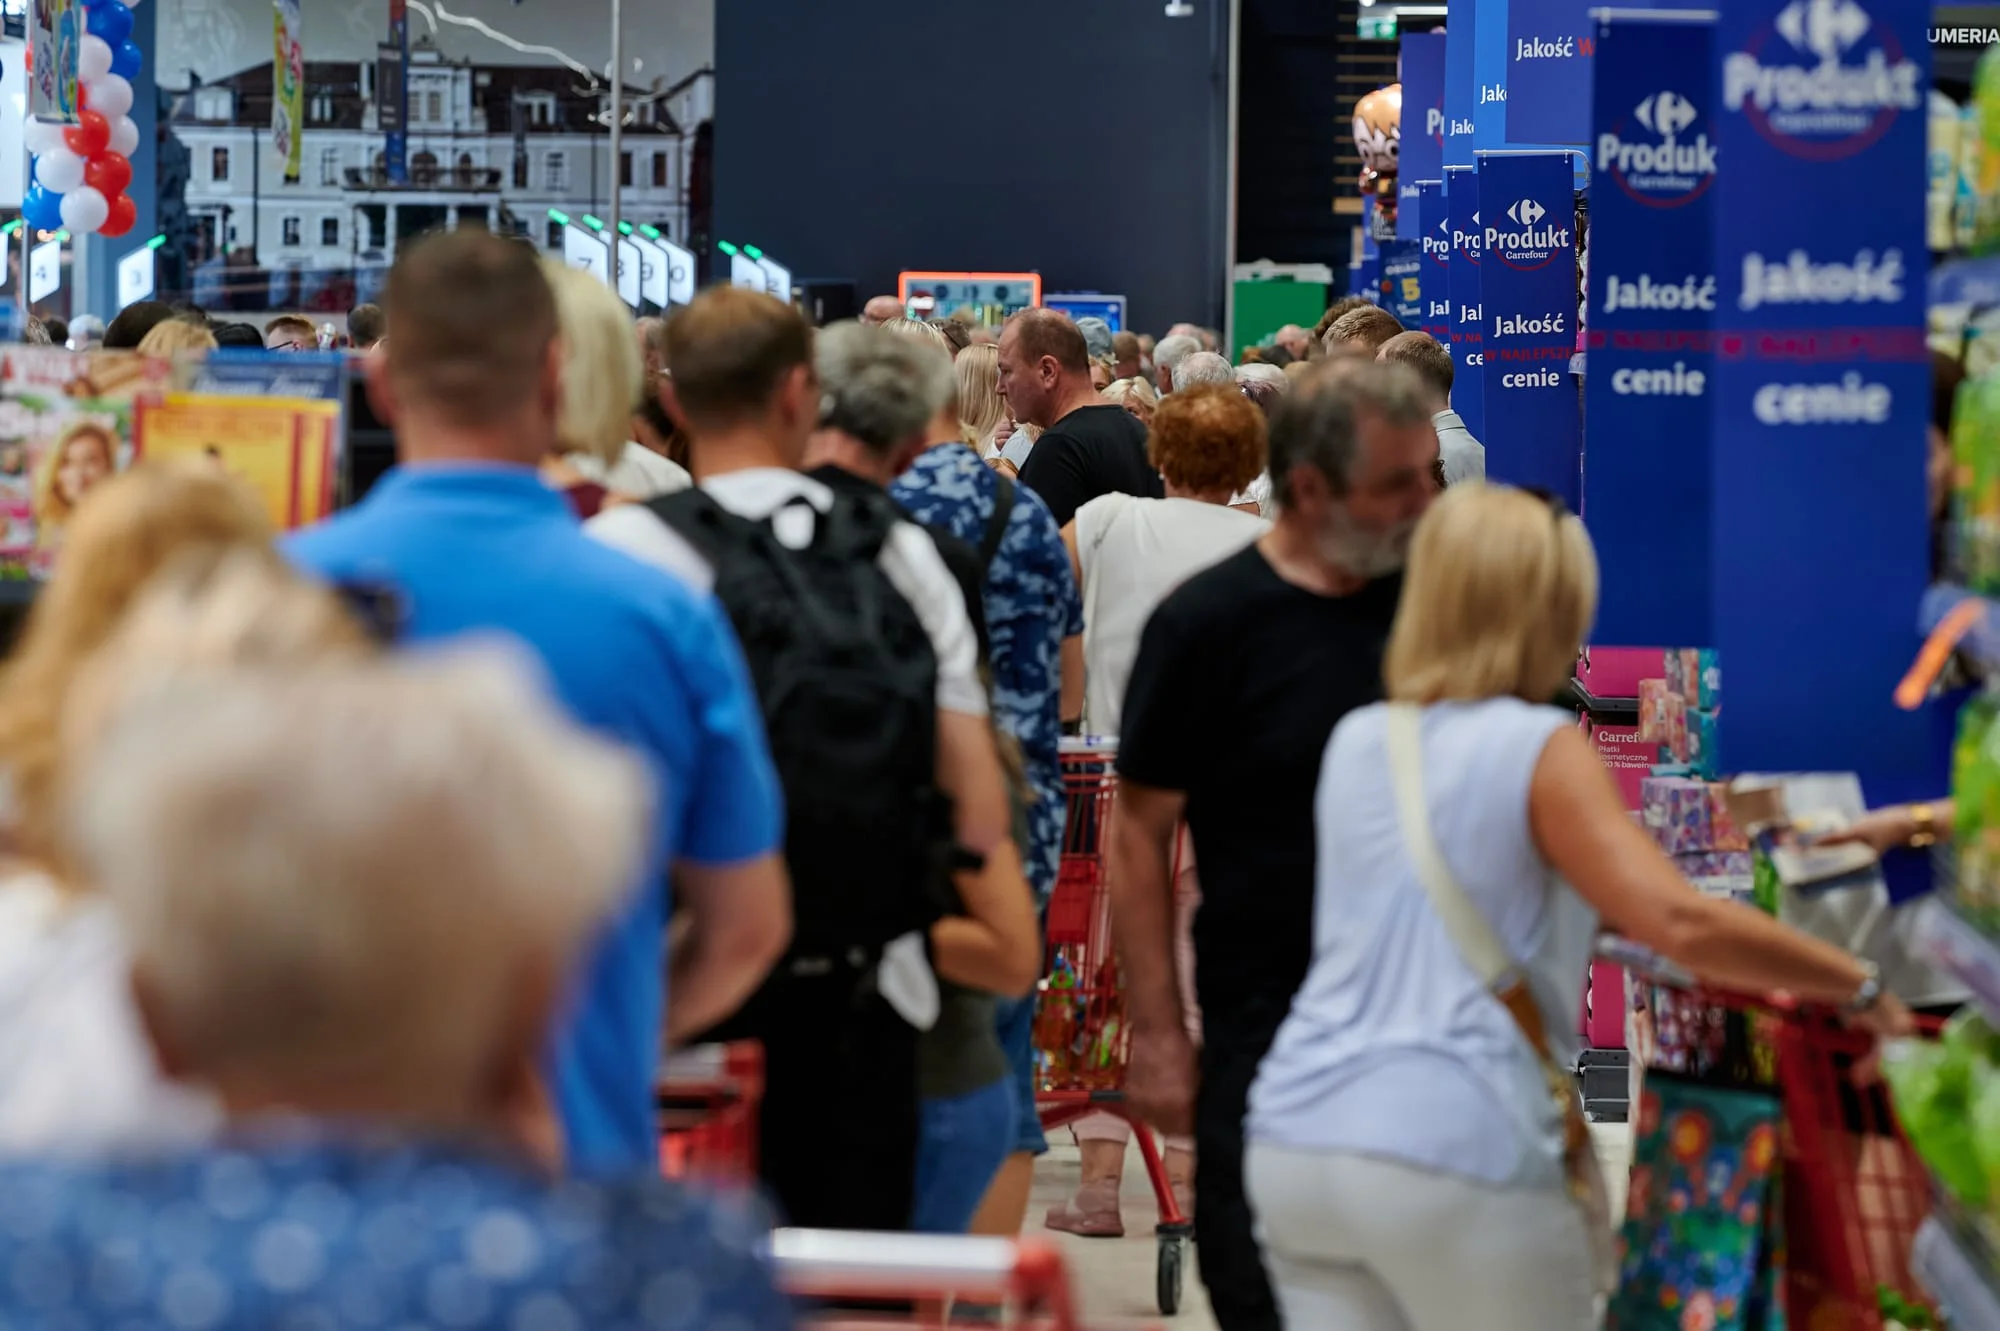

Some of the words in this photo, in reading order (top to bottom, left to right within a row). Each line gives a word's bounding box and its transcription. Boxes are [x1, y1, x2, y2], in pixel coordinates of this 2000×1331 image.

[1515, 35, 1573, 62] Jakość
[1927, 28, 2000, 44] UMERIA
[1722, 48, 1920, 111] Produkt
[1423, 236, 1449, 253] Pro
[1454, 230, 1480, 249] Pro
[1485, 225, 1569, 250] Produkt
[1505, 250, 1549, 260] Carrefour
[1736, 248, 1904, 312] Jakość
[1603, 273, 1717, 314] Jakość
[1493, 313, 1564, 338] Jakość
[1484, 350, 1496, 361] W
[1502, 368, 1560, 388] cenie
[1611, 361, 1706, 396] cenie
[1753, 369, 1892, 427] cenie
[1600, 753, 1648, 762] osmetyczne
